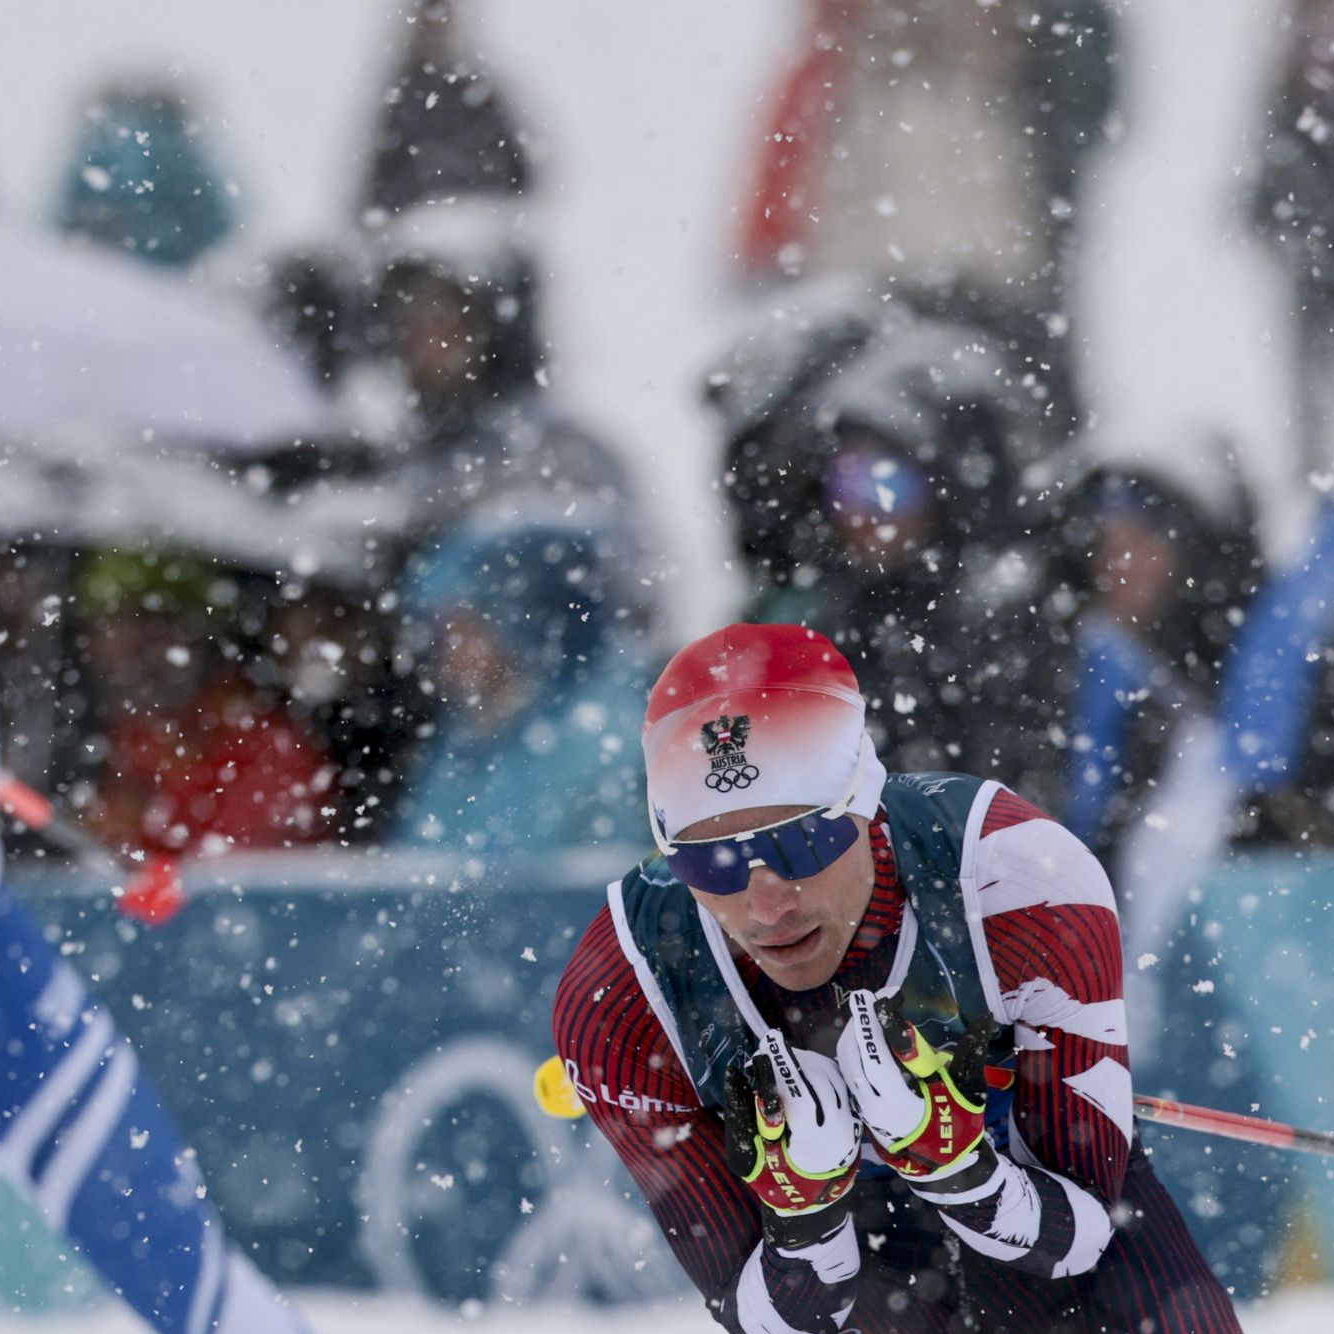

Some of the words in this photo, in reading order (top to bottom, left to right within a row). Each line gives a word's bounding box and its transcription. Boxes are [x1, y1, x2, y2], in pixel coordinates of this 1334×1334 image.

[711, 754, 747, 770] AUSTRIA
[854, 993, 881, 1065] ziener
[766, 1034, 802, 1098] ziener
[935, 1095, 954, 1154] LEKI
[765, 1154, 806, 1203] LEKI
